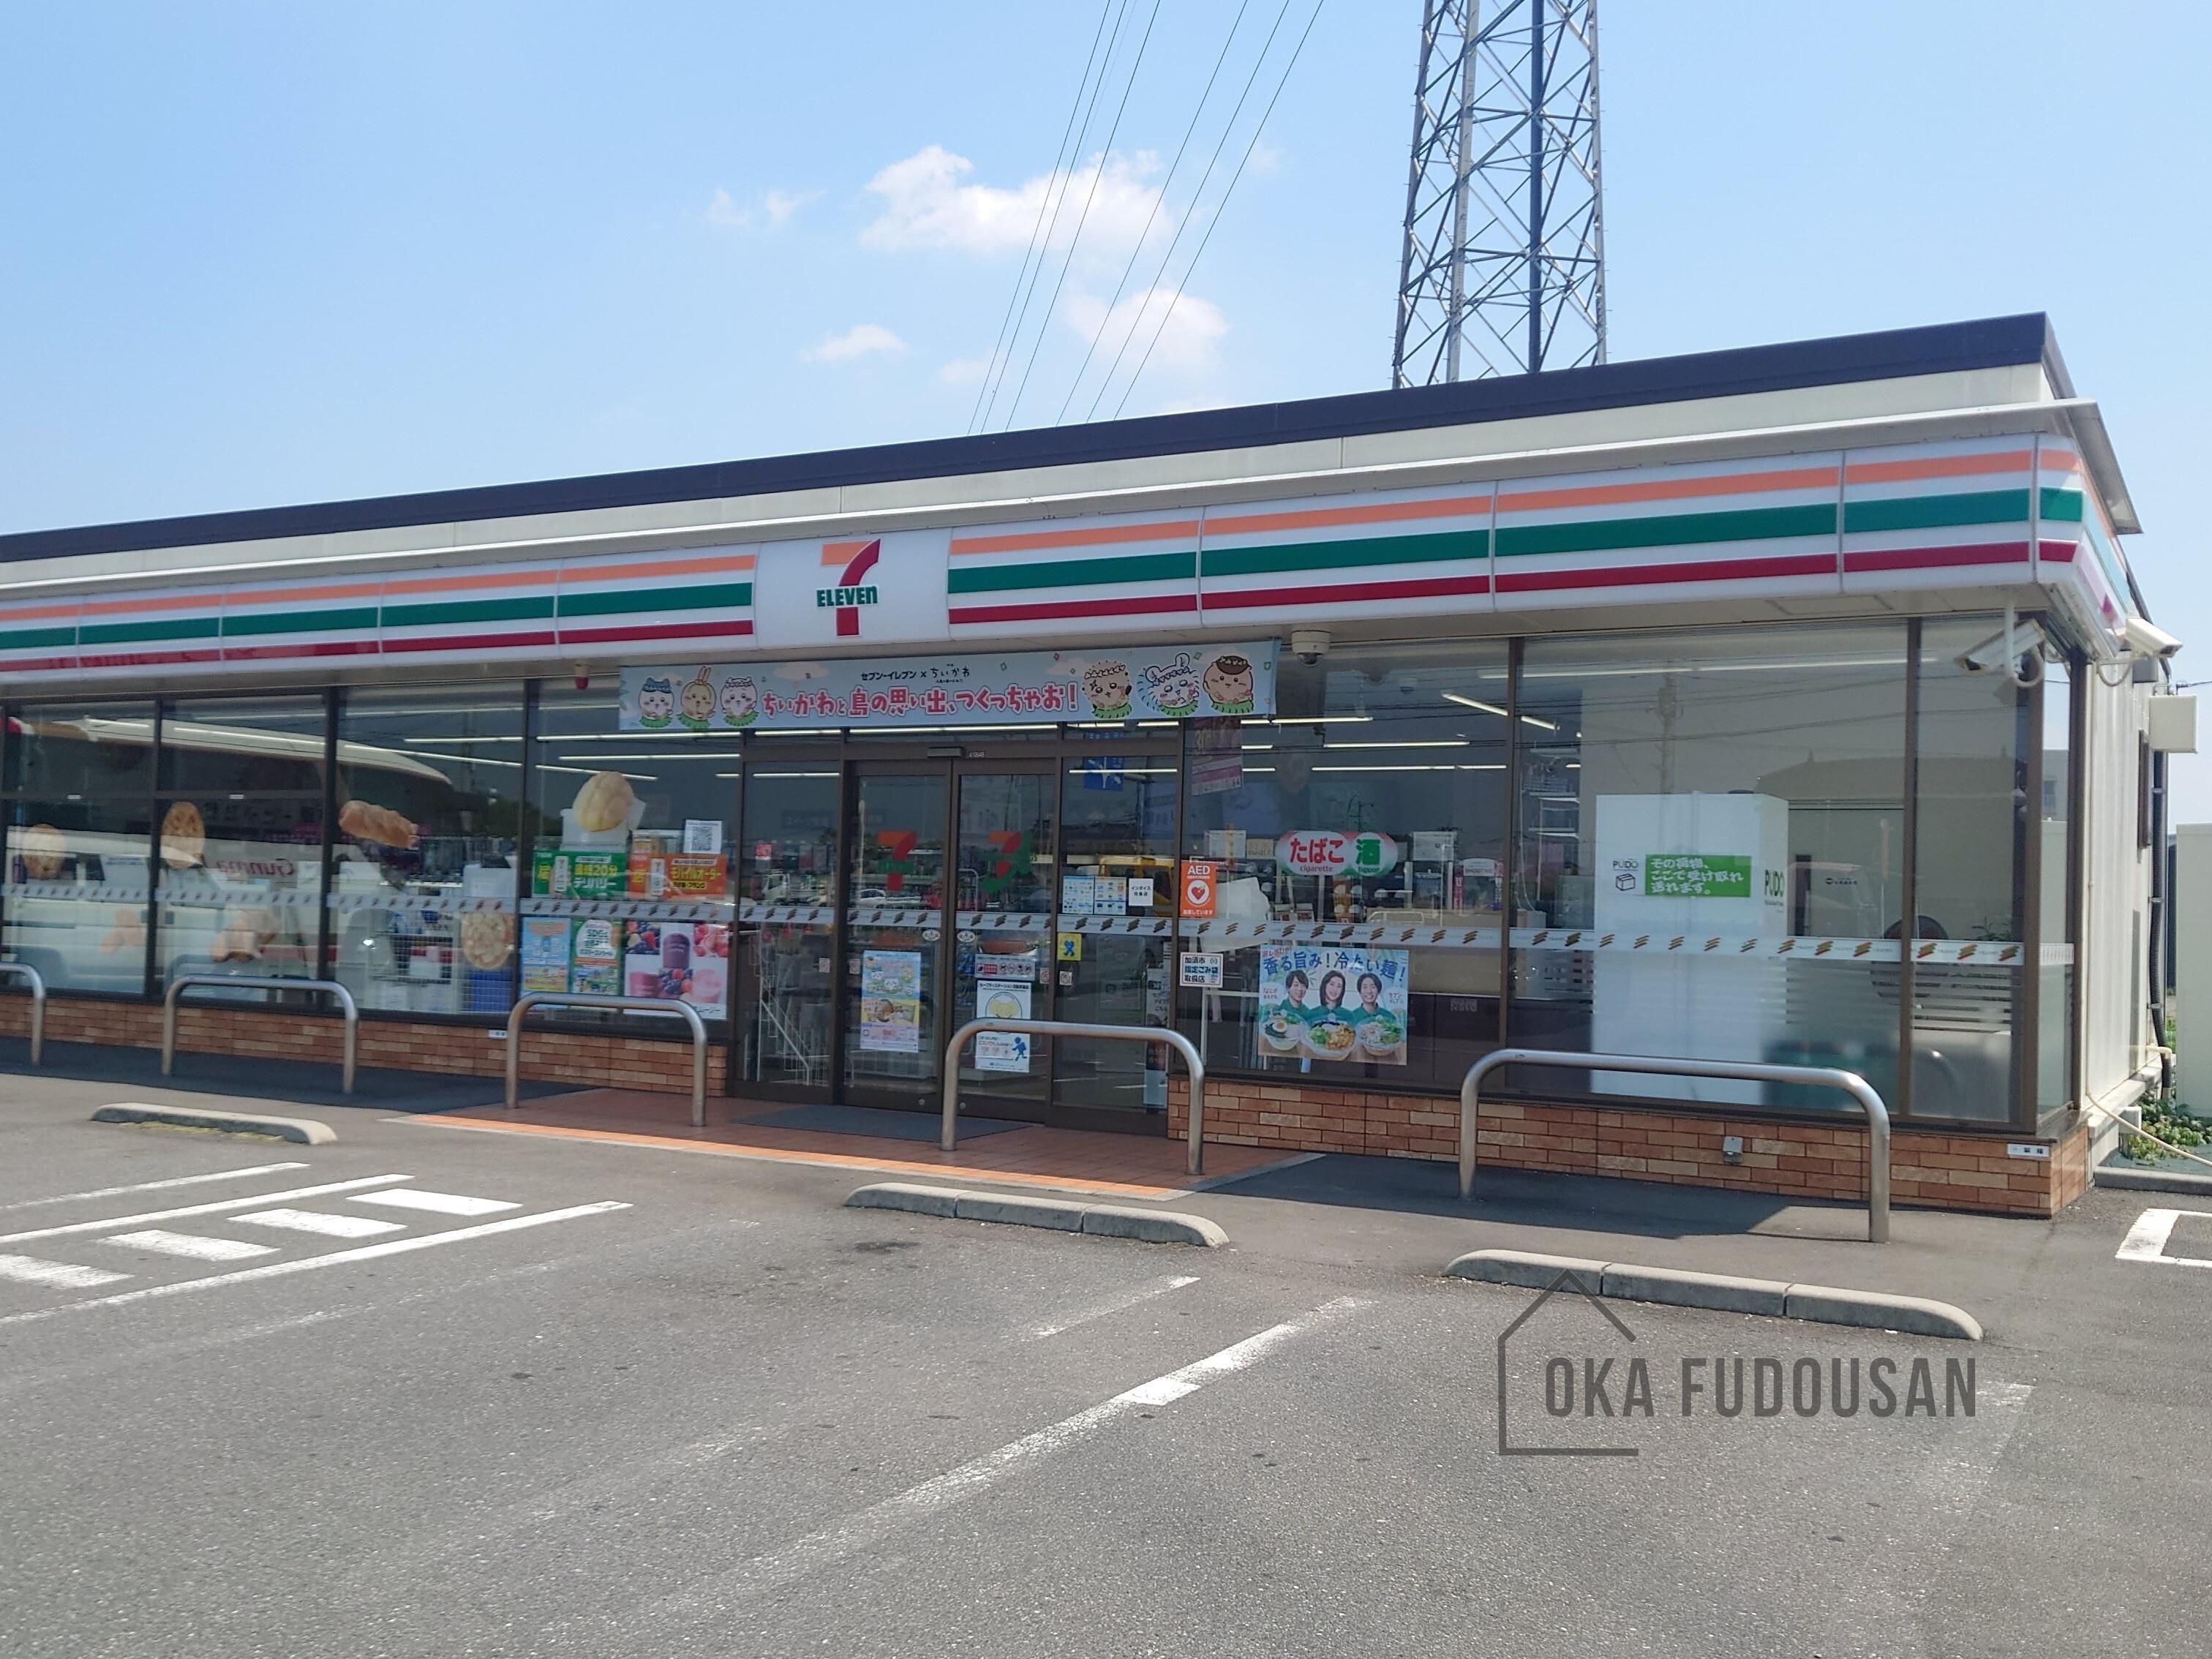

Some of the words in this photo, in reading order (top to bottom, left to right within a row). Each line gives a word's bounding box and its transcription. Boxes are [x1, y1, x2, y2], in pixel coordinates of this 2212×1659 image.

[1290, 837, 1344, 864] たばこ
[1355, 838, 1381, 865] 酒
[1187, 865, 1211, 876] AED
[1612, 859, 1639, 869] PUDO
